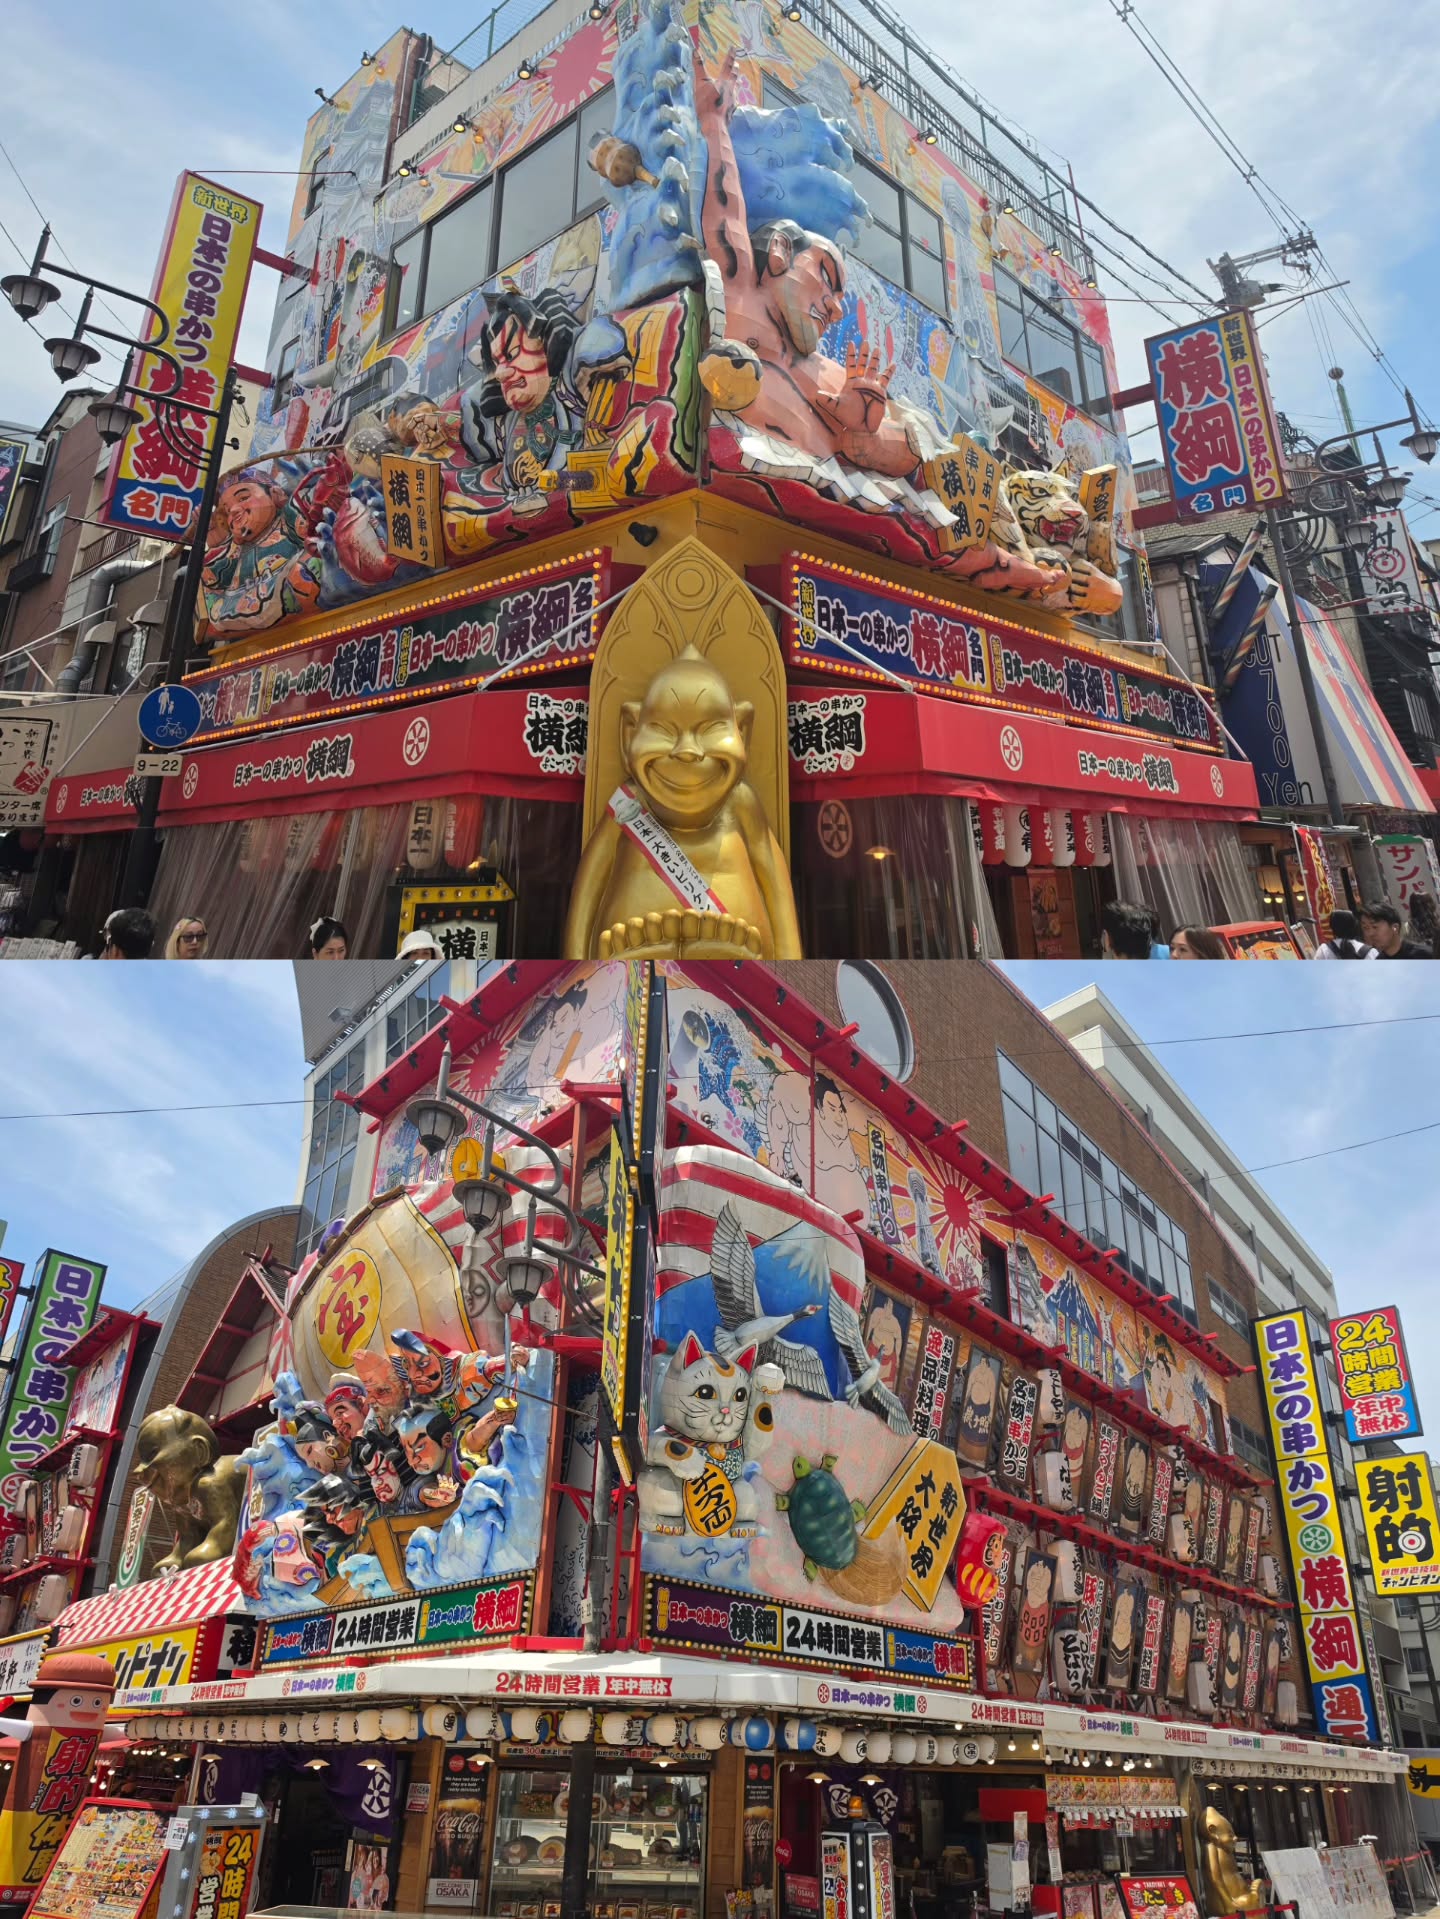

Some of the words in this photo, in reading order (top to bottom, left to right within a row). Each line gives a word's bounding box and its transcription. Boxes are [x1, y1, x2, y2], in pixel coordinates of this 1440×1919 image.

[193, 184, 249, 225] 新世界
[175, 212, 232, 363] 日本一の串かつ
[1222, 315, 1248, 363] 新世界
[132, 362, 216, 490] 横綱
[1157, 327, 1244, 486] 横綱
[1232, 363, 1277, 499] 日本一の串かつ
[122, 487, 194, 528] 名門
[388, 468, 413, 551] 横綱
[415, 468, 430, 563] 日本一の串かつ
[941, 458, 972, 543] 横綱
[1191, 485, 1246, 513] 名門
[408, 618, 497, 674] 日本一の串かつ
[493, 582, 573, 667] 横綱
[570, 576, 596, 651] 名門
[815, 597, 911, 656] 日本一の串かつ
[909, 609, 971, 683] 横綱
[967, 627, 987, 687] 名門
[272, 660, 332, 704] 日本一の串かつ
[330, 631, 383, 699] 横綱
[376, 628, 398, 687] 名門
[1003, 648, 1065, 698] 日本一の串かつ
[1063, 655, 1108, 715] 横綱
[1103, 668, 1119, 721] 名門
[214, 671, 253, 726] 横綱
[528, 694, 589, 716] 日本一の串
[787, 694, 867, 717] 日本一の串かつ
[1128, 685, 1172, 724] 日本一の串かつ
[1169, 688, 1200, 740] 横綱
[788, 708, 866, 758] 横綱
[233, 757, 303, 788] 日本一の串かつ
[305, 733, 353, 783] 横綱
[1077, 750, 1144, 782] 日本一の串かつ
[1142, 751, 1180, 794] 横綱
[1262, 773, 1314, 806] Yen
[869, 1129, 898, 1239] 名物串かつ
[1335, 1313, 1395, 1352] 24
[6, 1263, 95, 1469] 日本一の串かつ
[1342, 1345, 1399, 1376] 時間
[1345, 1366, 1402, 1399] 営業
[1003, 1376, 1028, 1477] 名物串かつ
[1264, 1318, 1330, 1522] 日本一の串かつ
[1355, 1394, 1405, 1418] 年中
[1357, 1412, 1409, 1436] 無休
[895, 1469, 937, 1540] 大阪
[1369, 1460, 1435, 1564] 射的
[911, 1482, 959, 1579] 新世界
[1381, 1572, 1440, 1588] チャンピオン
[334, 1606, 416, 1648] 24時間営業
[427, 1604, 473, 1630] 日本一の串かつ
[472, 1584, 522, 1633] 横綱
[668, 1601, 729, 1628] 日本一の串かつ
[728, 1601, 778, 1647] 横綱
[1300, 1556, 1359, 1674] 横綱
[272, 1633, 302, 1652] 日本一の串かつ
[300, 1618, 333, 1654] 横綱
[786, 1615, 883, 1662] 24時間営業
[895, 1642, 933, 1664] 日本一の串かつ
[932, 1642, 966, 1676] 横綱
[290, 1676, 335, 1693] 日本一の串かつ
[334, 1671, 357, 1692] 横綱
[495, 1671, 601, 1695] 24時間営業
[608, 1677, 669, 1695] 年中無休
[831, 1688, 891, 1707] 日本一の串かつ
[893, 1693, 916, 1713] 横綱
[971, 1702, 1017, 1725] 24時間営業
[35, 1735, 97, 1814] 射的
[436, 1887, 470, 1898] OSAKA
